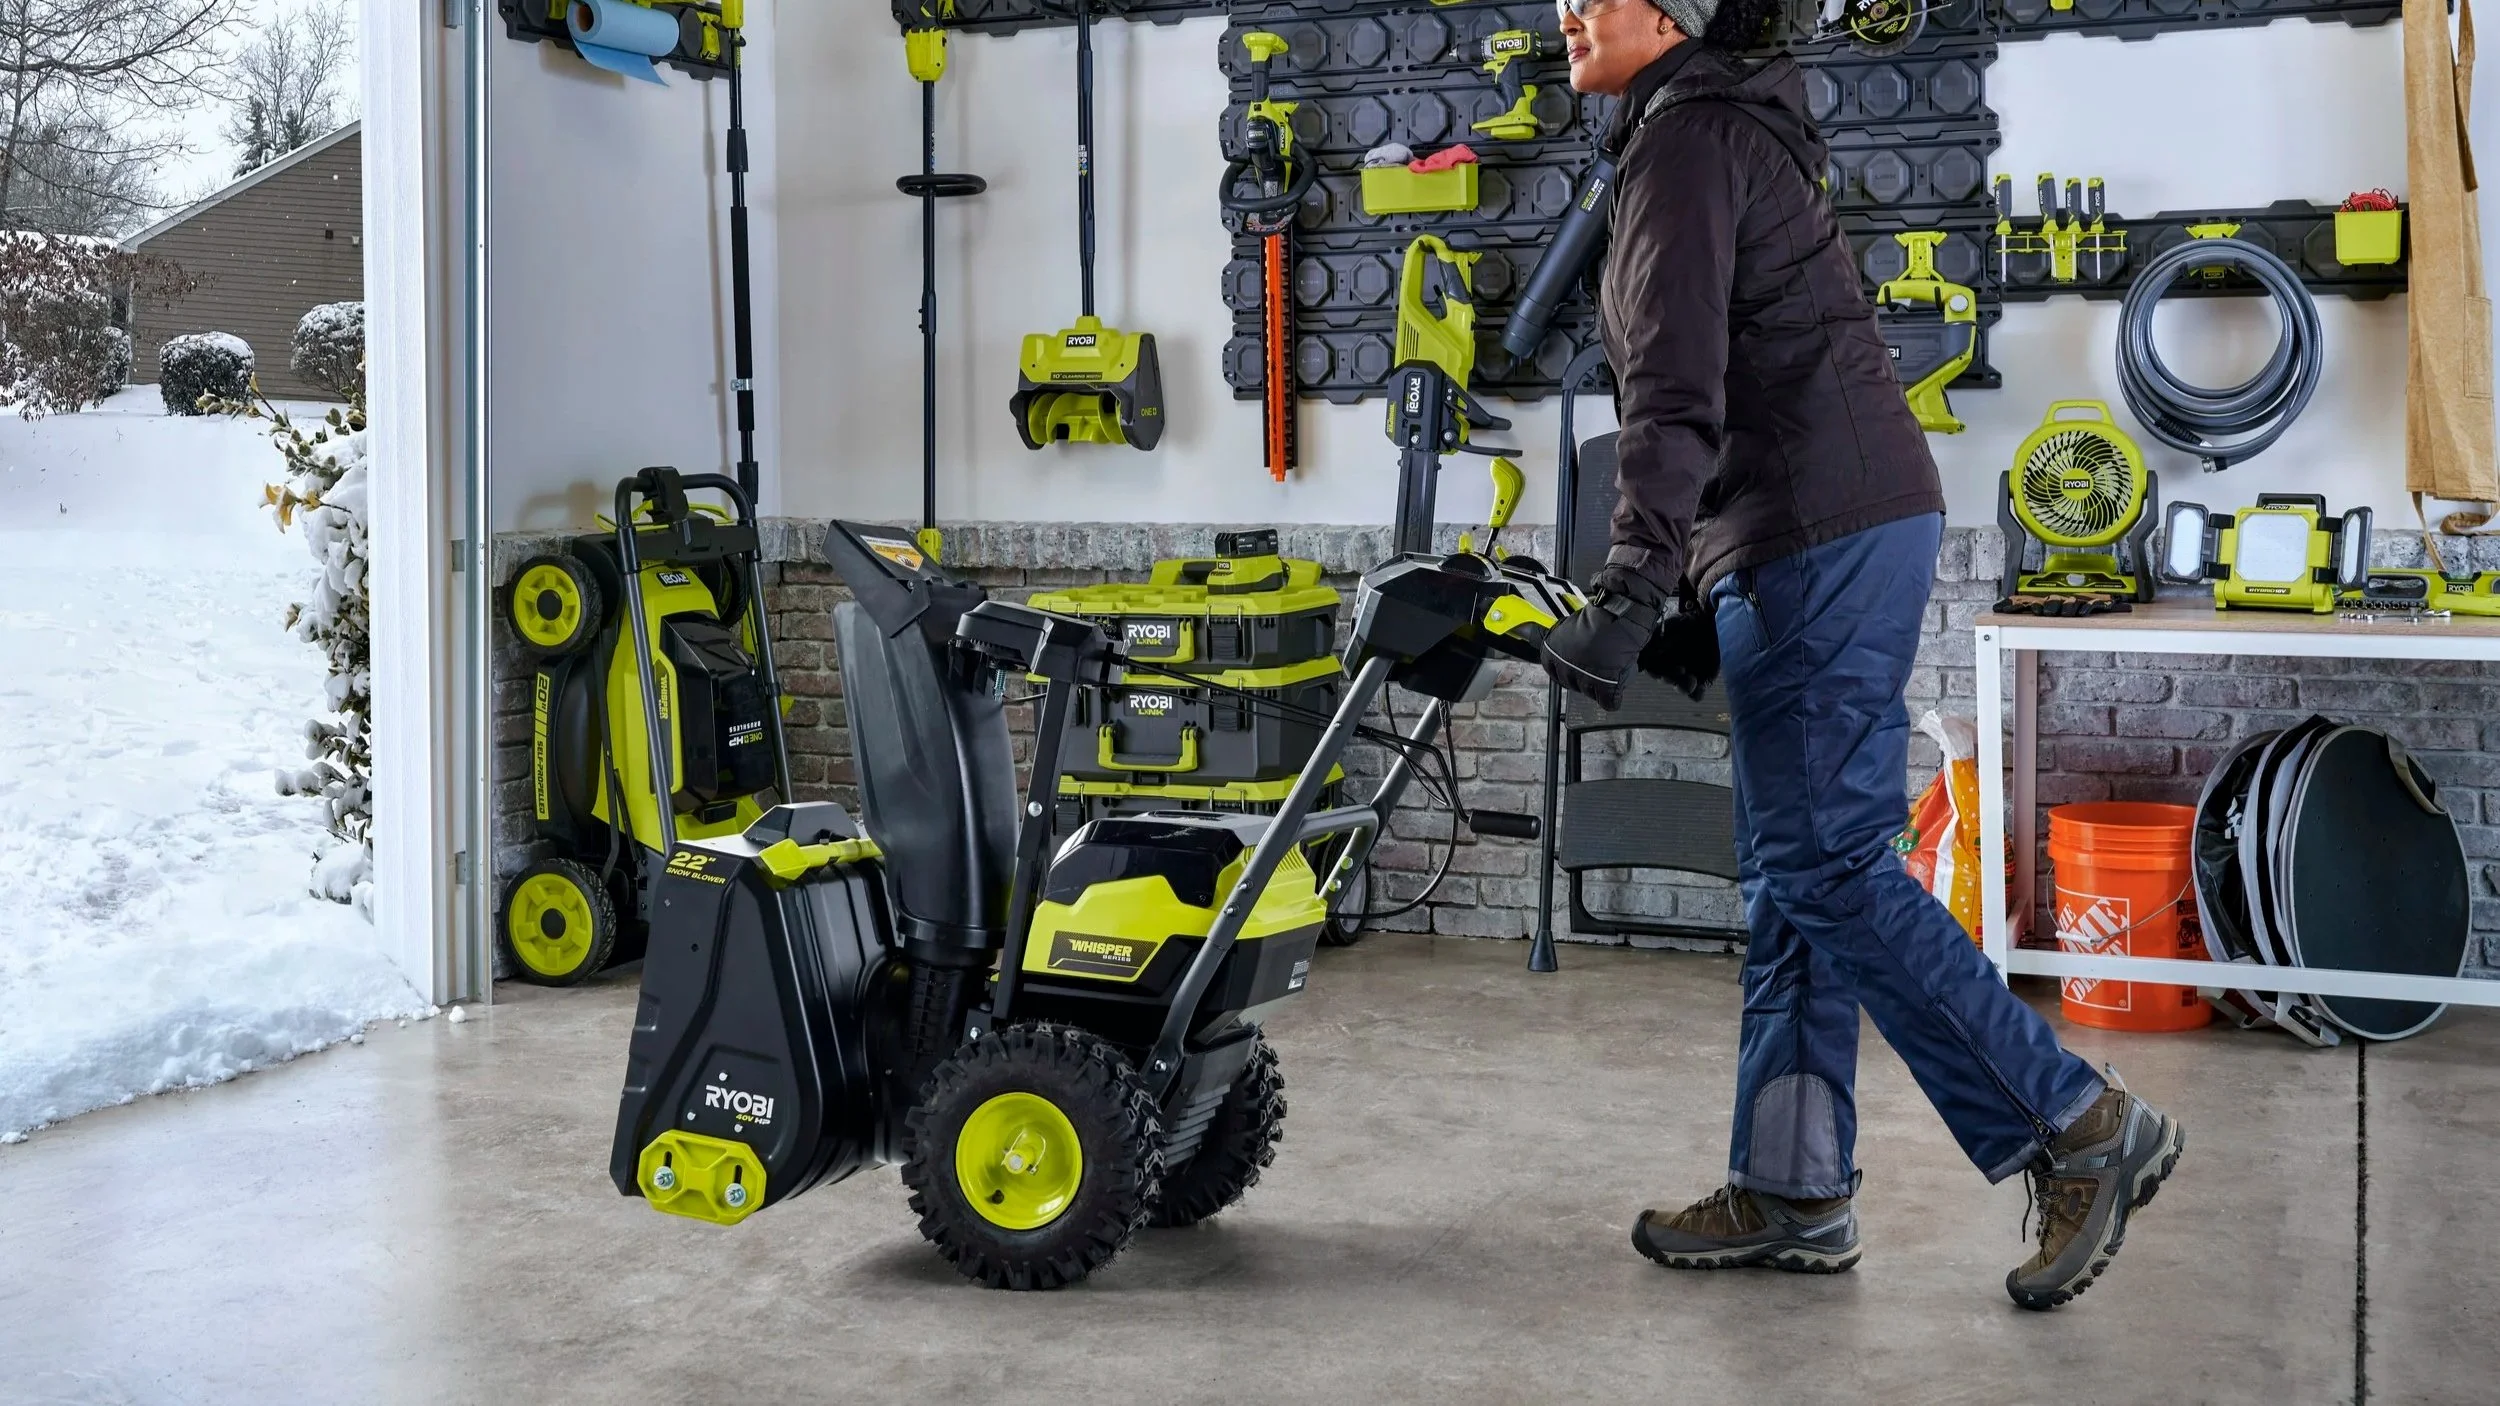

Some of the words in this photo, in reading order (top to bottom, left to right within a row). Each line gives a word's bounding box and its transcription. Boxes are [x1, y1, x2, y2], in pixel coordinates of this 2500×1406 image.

[1496, 38, 1523, 49] RYOBI
[1068, 336, 1095, 345] RYOBI
[1409, 377, 1420, 413] RYOBI
[2064, 480, 2089, 488] RYOBI
[659, 572, 689, 585] RYOBI
[2447, 584, 2473, 592] RYOBI
[1127, 624, 1171, 638] RYOBI
[537, 677, 547, 710] 20"
[660, 674, 668, 719] WHISPER
[1129, 694, 1173, 709] RYOBI
[729, 720, 761, 733] BRUSHLESS
[537, 740, 545, 814] SELF-PROPELLED
[669, 851, 717, 871] 22"
[666, 867, 691, 877] SNOW
[691, 872, 726, 884] BLOWER
[1068, 938, 1133, 957] WHISPER
[1102, 954, 1131, 962] SERIES
[705, 1084, 775, 1119] RYOBI
[735, 1113, 754, 1122] 40V
[754, 1117, 771, 1125] HP
